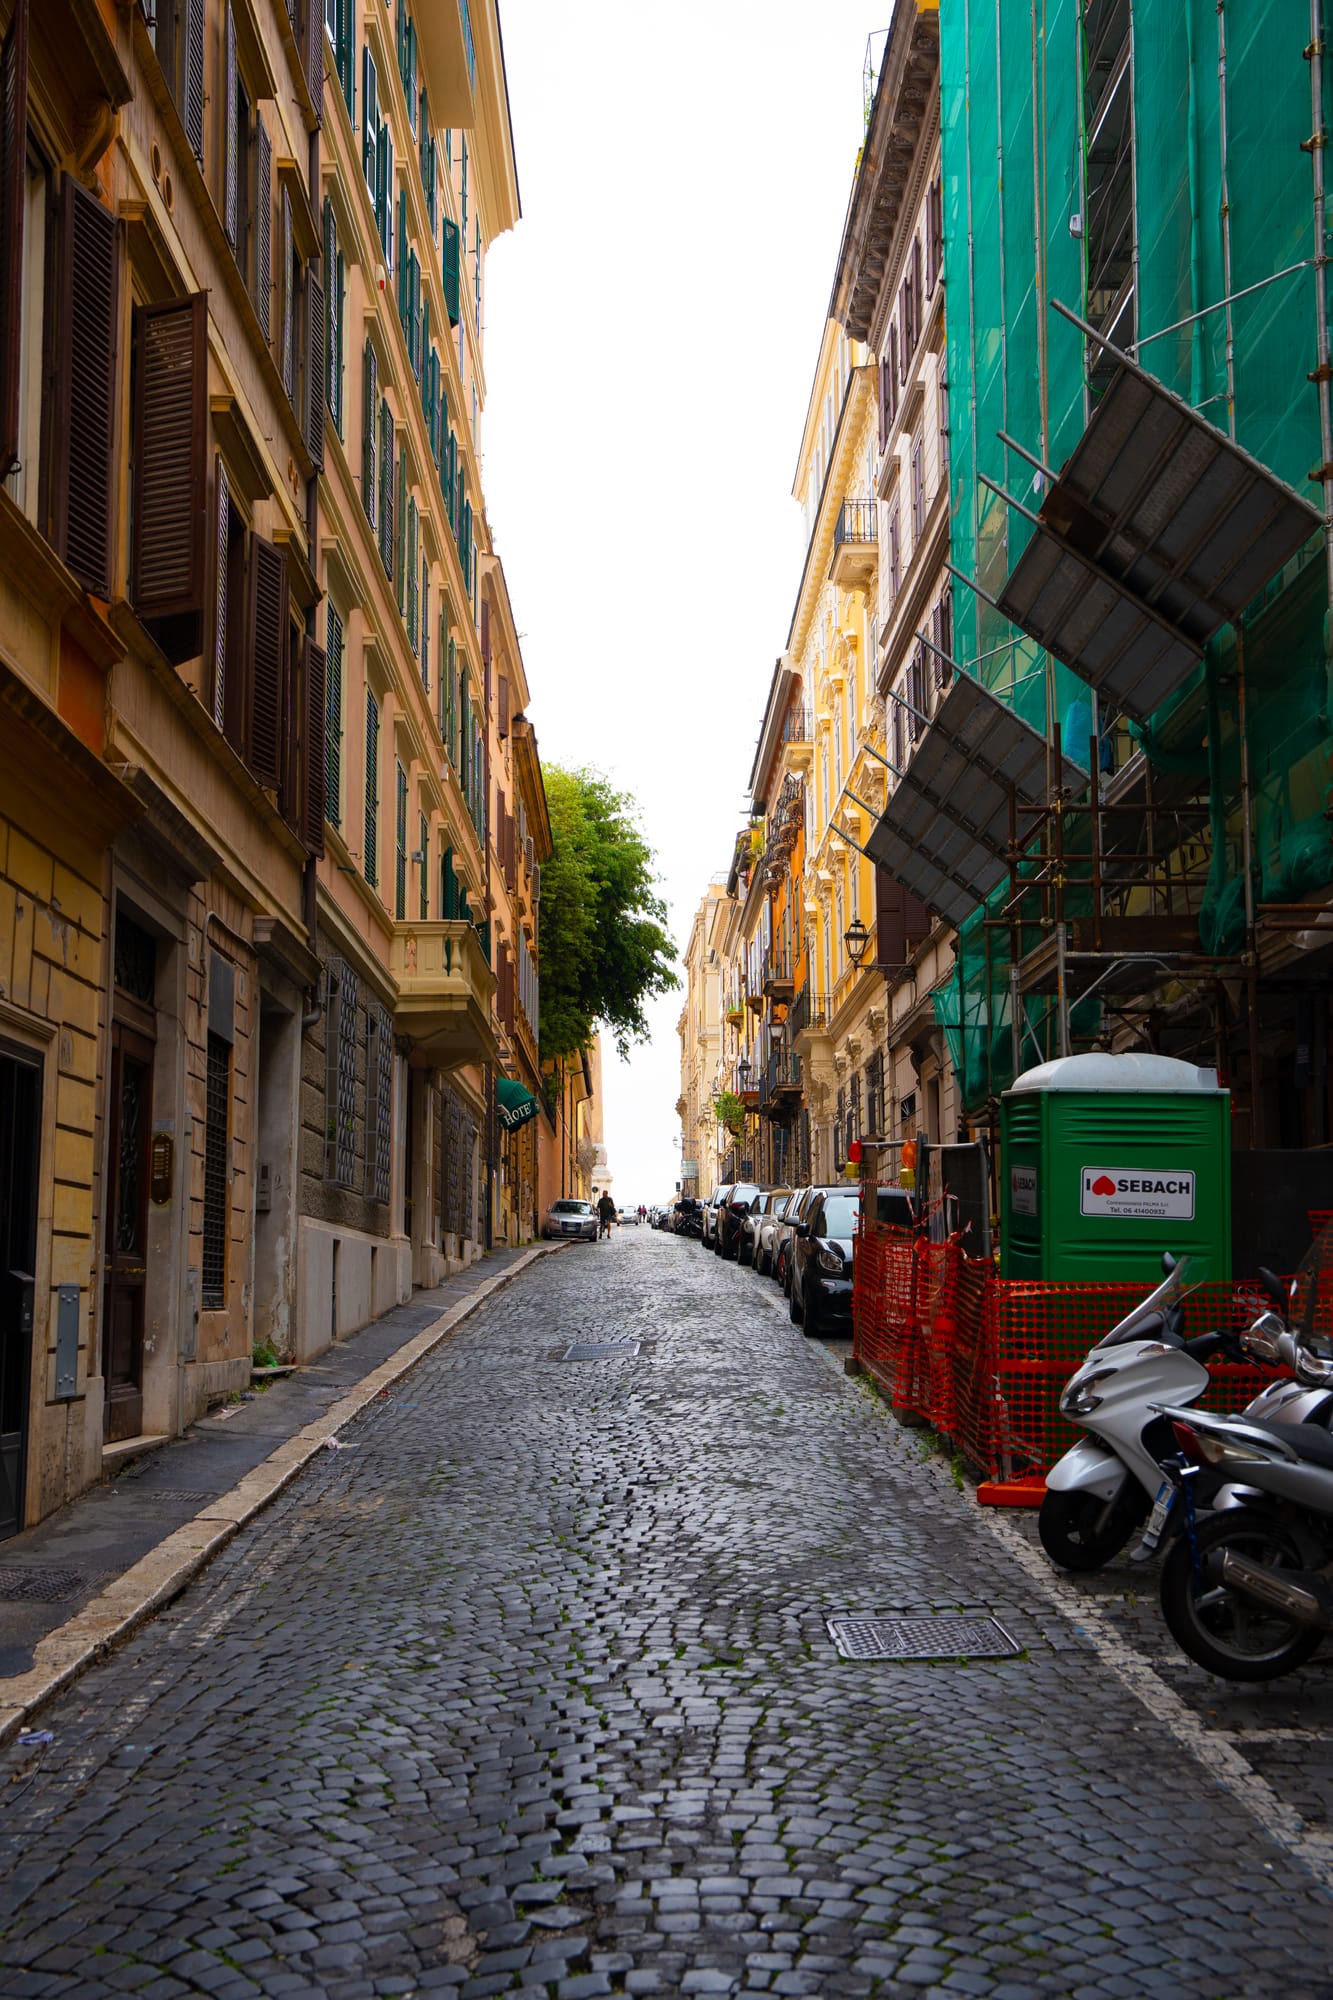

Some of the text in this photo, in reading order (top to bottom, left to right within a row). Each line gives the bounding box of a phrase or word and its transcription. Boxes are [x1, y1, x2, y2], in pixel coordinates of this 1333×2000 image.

[504, 1102, 532, 1126] HOTE
[1086, 1178, 1191, 1195] I SEBACH
